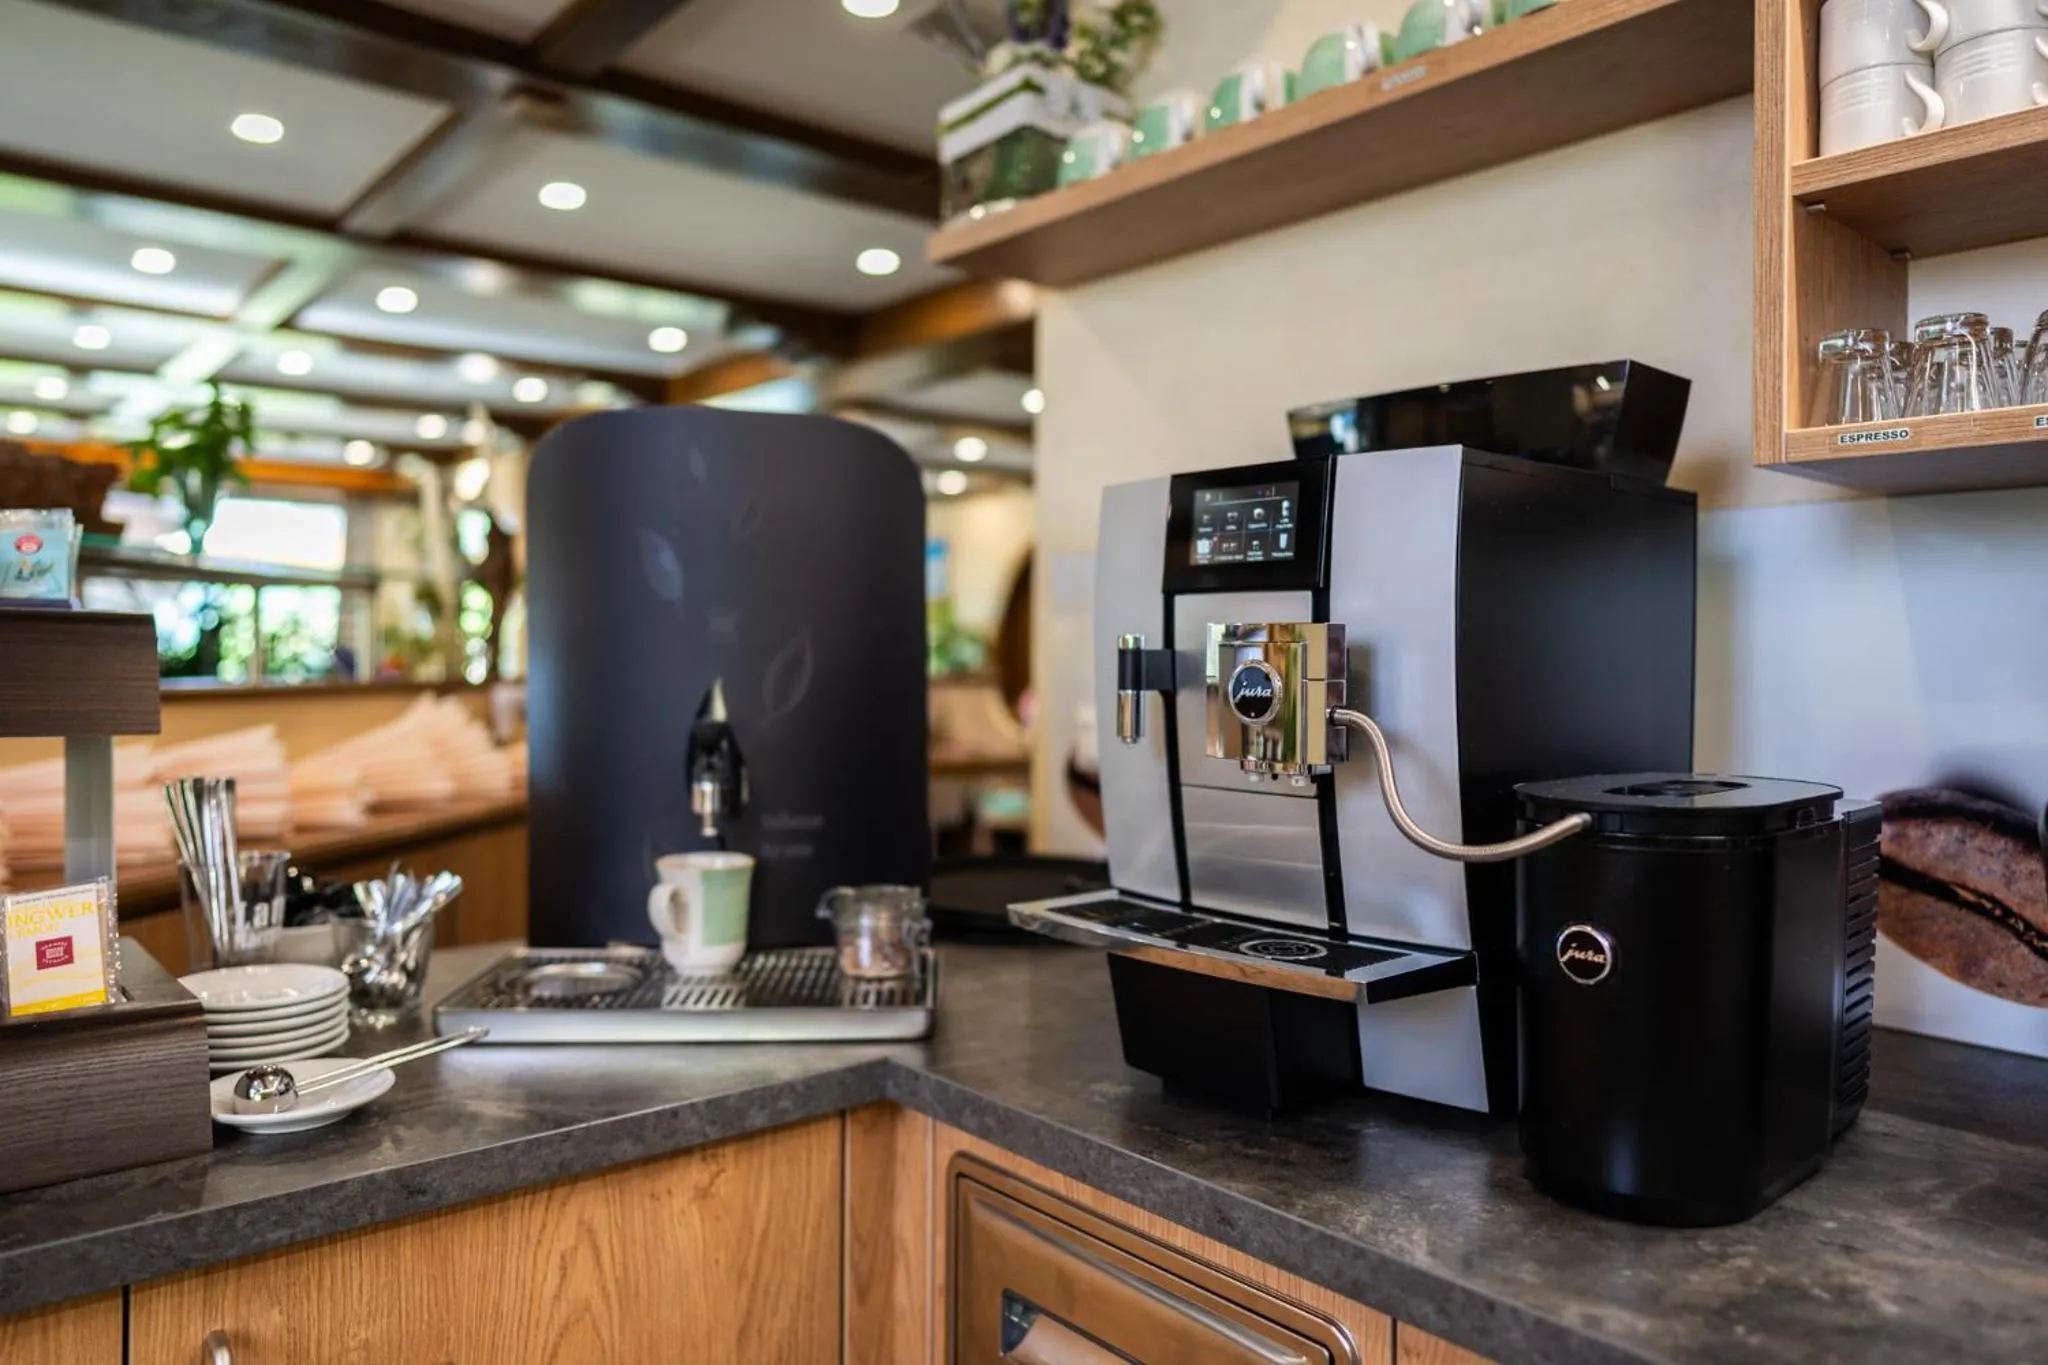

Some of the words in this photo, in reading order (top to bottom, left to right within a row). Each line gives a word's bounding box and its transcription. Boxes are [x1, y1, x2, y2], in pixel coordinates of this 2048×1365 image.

[1839, 429, 1909, 444] ESPRESSO
[1234, 681, 1273, 704] jura
[8, 900, 94, 928] INGWER
[1560, 942, 1606, 963] jura
